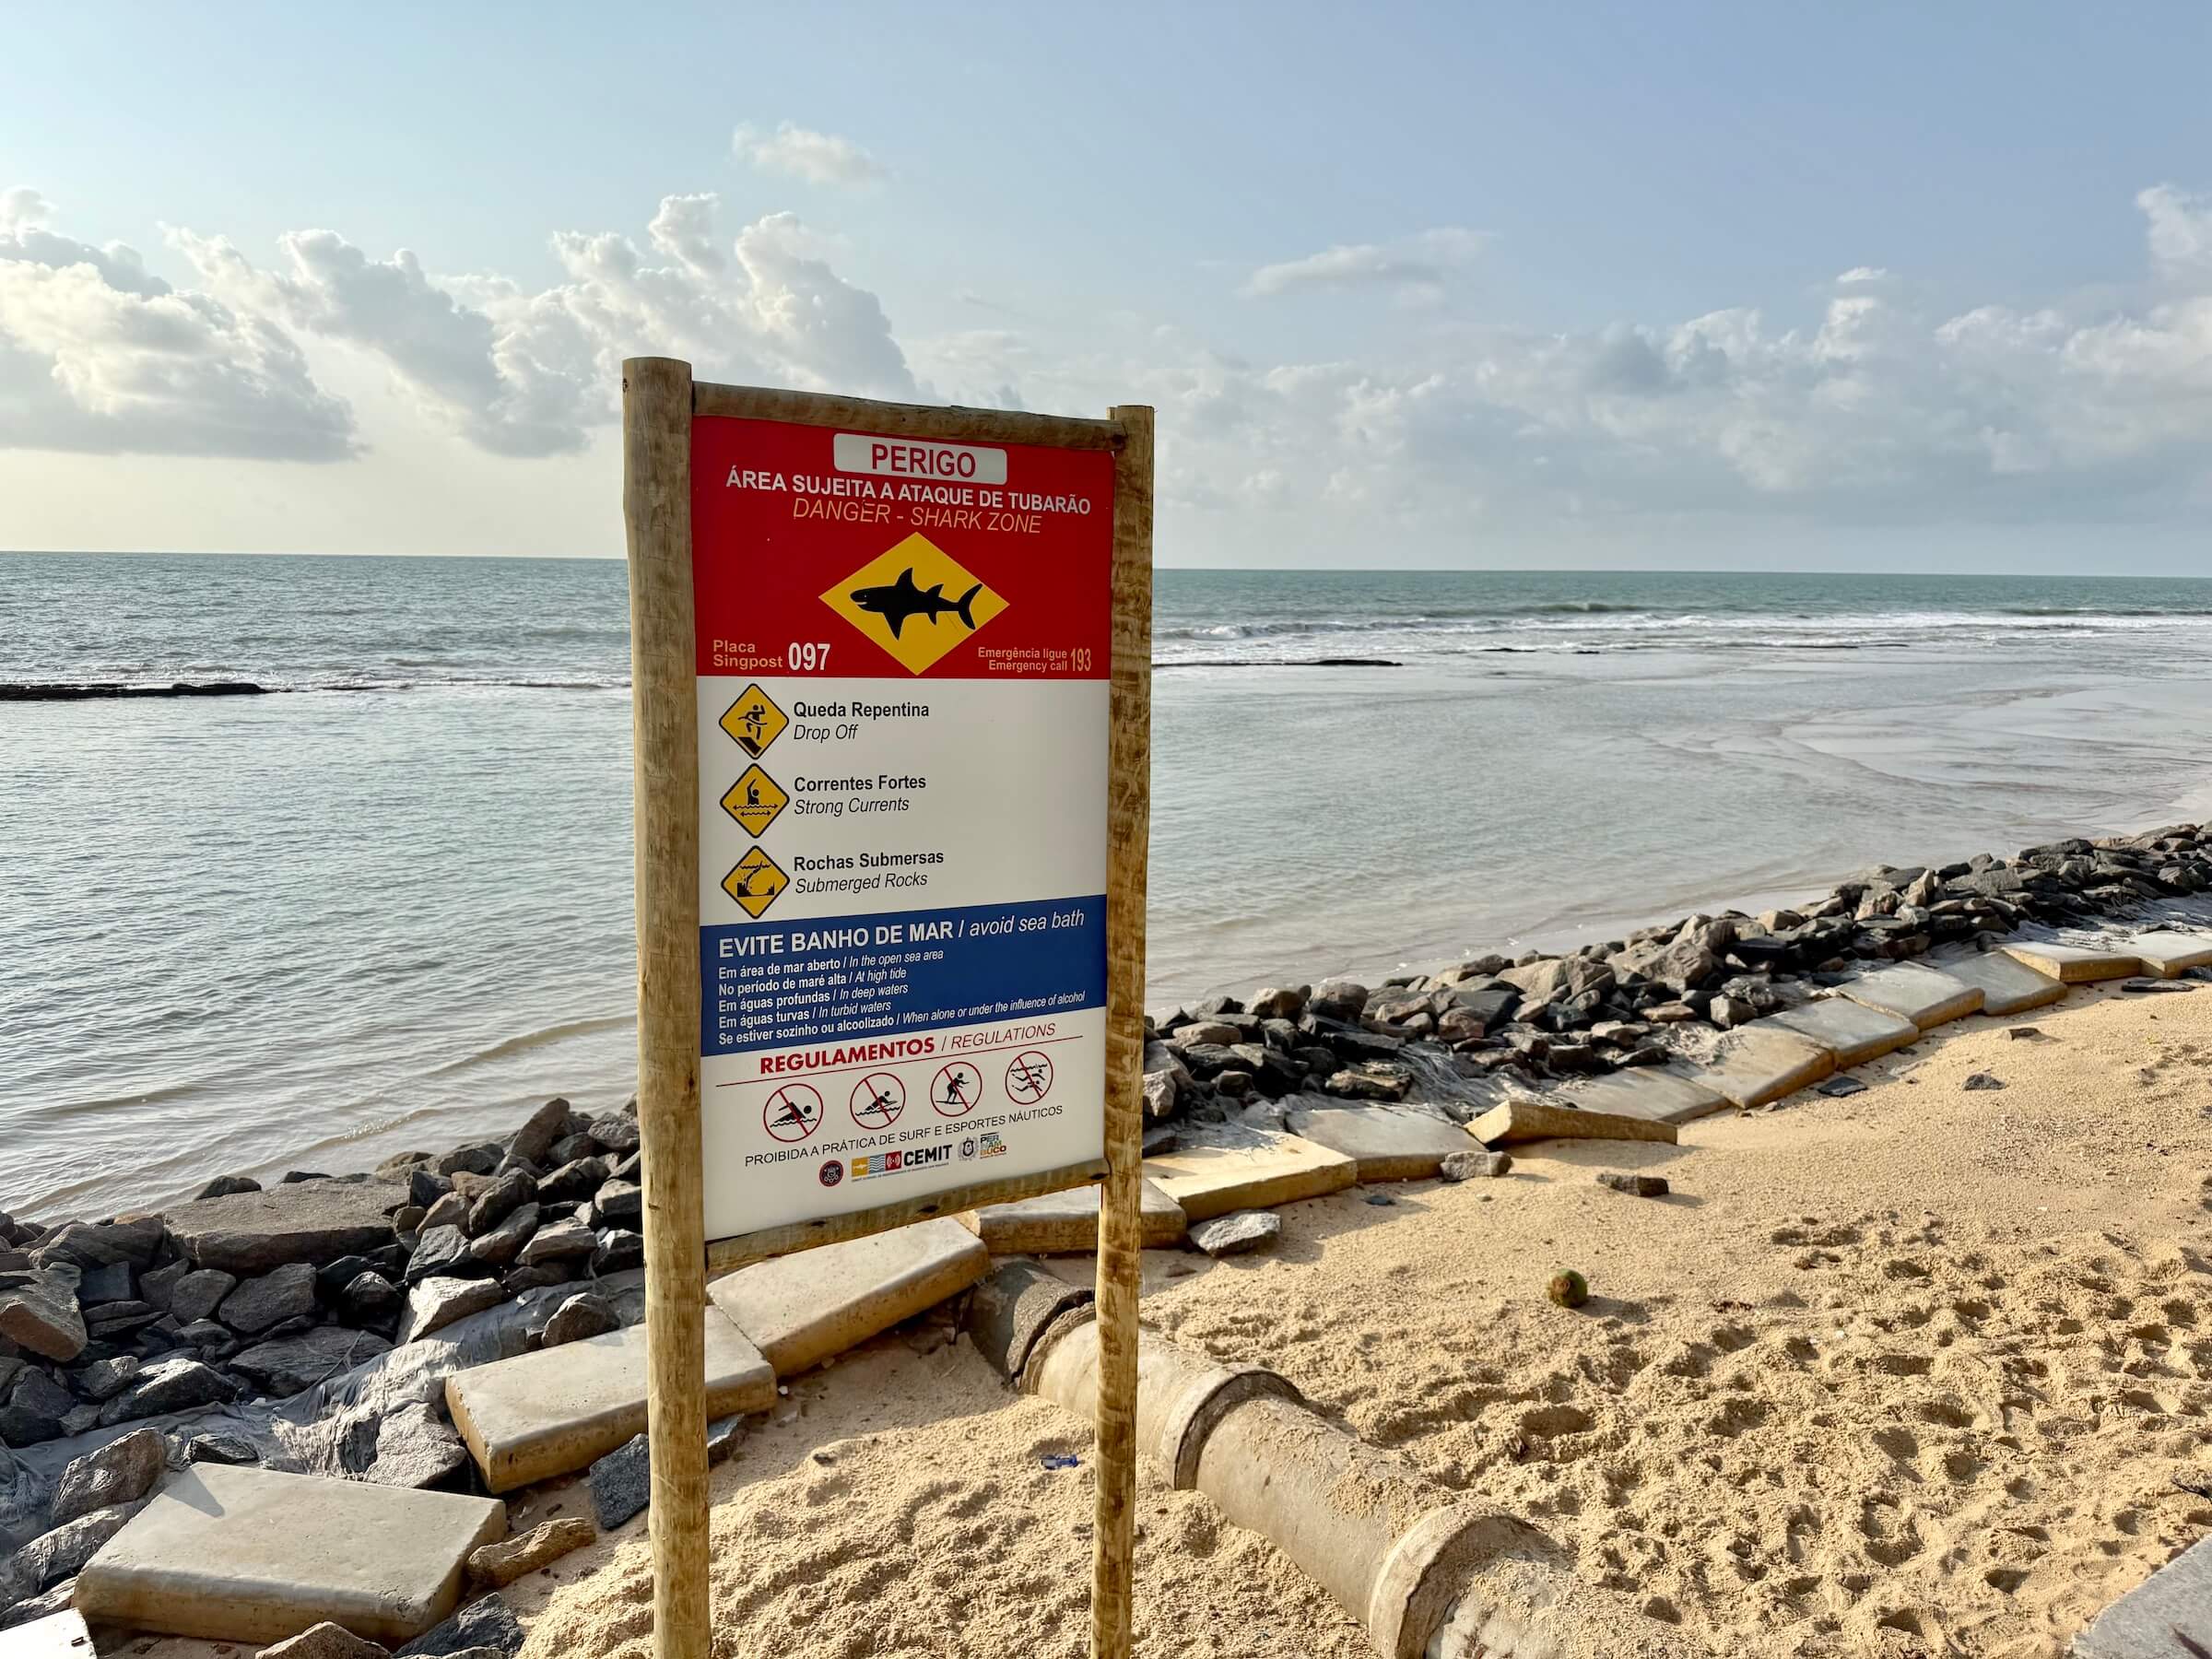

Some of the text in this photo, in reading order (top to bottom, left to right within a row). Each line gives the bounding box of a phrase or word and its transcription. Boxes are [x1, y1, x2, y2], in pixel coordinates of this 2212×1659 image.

[872, 444, 975, 477] PERIGO
[726, 465, 1091, 515] ÁREA SUJEITA A ATAQUE DE TUBARÃO
[794, 498, 891, 524] DANGER
[911, 507, 982, 530] SHARK
[987, 512, 1042, 534] ZONE
[713, 640, 756, 653] Placa
[788, 641, 830, 671] 097
[978, 647, 1067, 661] Emergência ligue
[713, 654, 782, 670] Singpost
[988, 660, 1067, 673] Emergency call
[1071, 648, 1091, 671] 193
[794, 701, 929, 720] Queda Repentina
[794, 724, 859, 743] Drop Off
[794, 775, 926, 792] Correntes Fortes
[794, 796, 910, 817] Strong Currents
[794, 852, 944, 871] Rochas Submersas
[795, 872, 927, 893] Submerged Rocks
[719, 935, 783, 959] EVITE
[792, 928, 869, 952] BANHO
[876, 925, 902, 946] DE
[909, 921, 953, 942] MAR
[970, 915, 1014, 936] avoid
[1018, 920, 1047, 932] sea
[1051, 909, 1085, 929] bath
[719, 967, 736, 980] Em
[740, 964, 764, 978] área
[767, 963, 781, 975] de
[783, 962, 804, 974] mar
[807, 959, 841, 971] aberto
[850, 956, 859, 967] In
[861, 955, 876, 967] the
[878, 953, 901, 966] open
[904, 953, 921, 963] sea
[924, 949, 944, 960] area
[719, 983, 734, 996] No
[737, 980, 780, 996] período
[782, 977, 794, 989] de
[799, 974, 825, 989] maré
[828, 973, 846, 985] alta
[854, 971, 865, 982] At
[867, 970, 887, 984] high
[889, 968, 907, 979] tide
[719, 1000, 736, 1012] Em
[740, 997, 773, 1013] águas
[777, 992, 830, 1008] profundas
[840, 989, 849, 1000] In
[852, 986, 876, 1001] deep
[877, 983, 908, 996] waters
[719, 1017, 736, 1029] Em
[740, 1013, 773, 1029] águas
[776, 1009, 809, 1023] turvas
[818, 1006, 829, 1018] In
[830, 1002, 858, 1018] turbid
[861, 1000, 891, 1014] waters
[719, 1033, 733, 1045] Se
[736, 1029, 773, 1043] estiver
[776, 1024, 818, 1040] sozinho
[821, 1023, 834, 1034] ou
[837, 1016, 894, 1032] alcoolizado
[902, 1012, 929, 1024] When
[931, 1007, 956, 1020] alone
[958, 1006, 967, 1017] or
[969, 1003, 994, 1016] under
[995, 1001, 1008, 1013] the
[1010, 997, 1046, 1011] influence
[1048, 994, 1057, 1006] of
[1057, 991, 1086, 1005] alcohol
[759, 1037, 935, 1075] REGULAMENTOS
[951, 1023, 1056, 1051] REGULATIONS
[745, 1104, 1063, 1167] PROIBIDA A PRÁTICA DE SURF E ESPORTES NÁUTICOS
[903, 1144, 952, 1167] CEMIT
